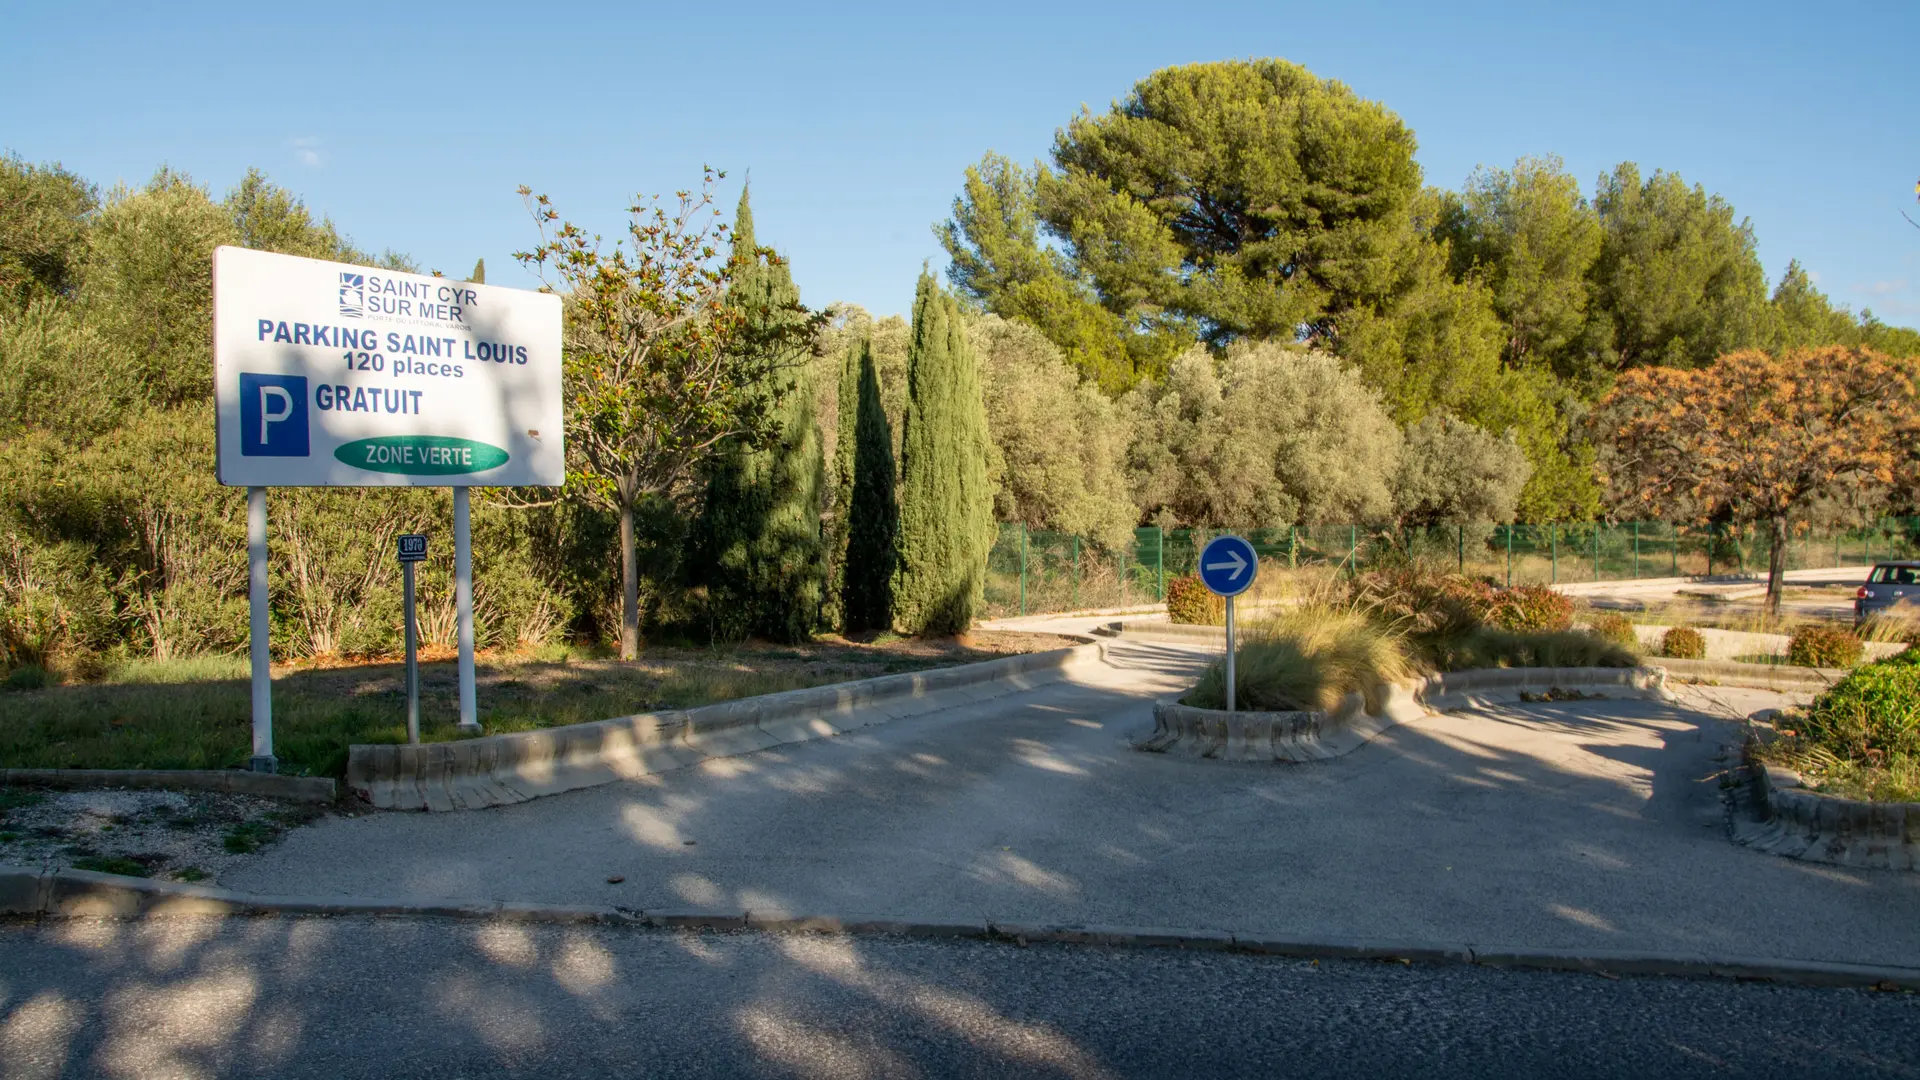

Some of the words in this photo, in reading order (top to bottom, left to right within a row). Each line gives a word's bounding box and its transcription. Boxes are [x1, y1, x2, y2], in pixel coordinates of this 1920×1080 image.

[368, 276, 431, 300] SAINT
[437, 286, 478, 306] CYR
[367, 315, 392, 323] PORTE
[368, 296, 412, 317] SUR
[419, 302, 463, 322] MER
[258, 319, 378, 351] PARKING
[386, 332, 457, 358] SAINT
[464, 339, 528, 365] LOUIS
[343, 351, 385, 372] 120
[393, 356, 464, 378] places
[315, 383, 423, 415] GRATUIT
[260, 386, 293, 445] P
[365, 444, 414, 465] ZONE
[417, 446, 473, 466] VERTE
